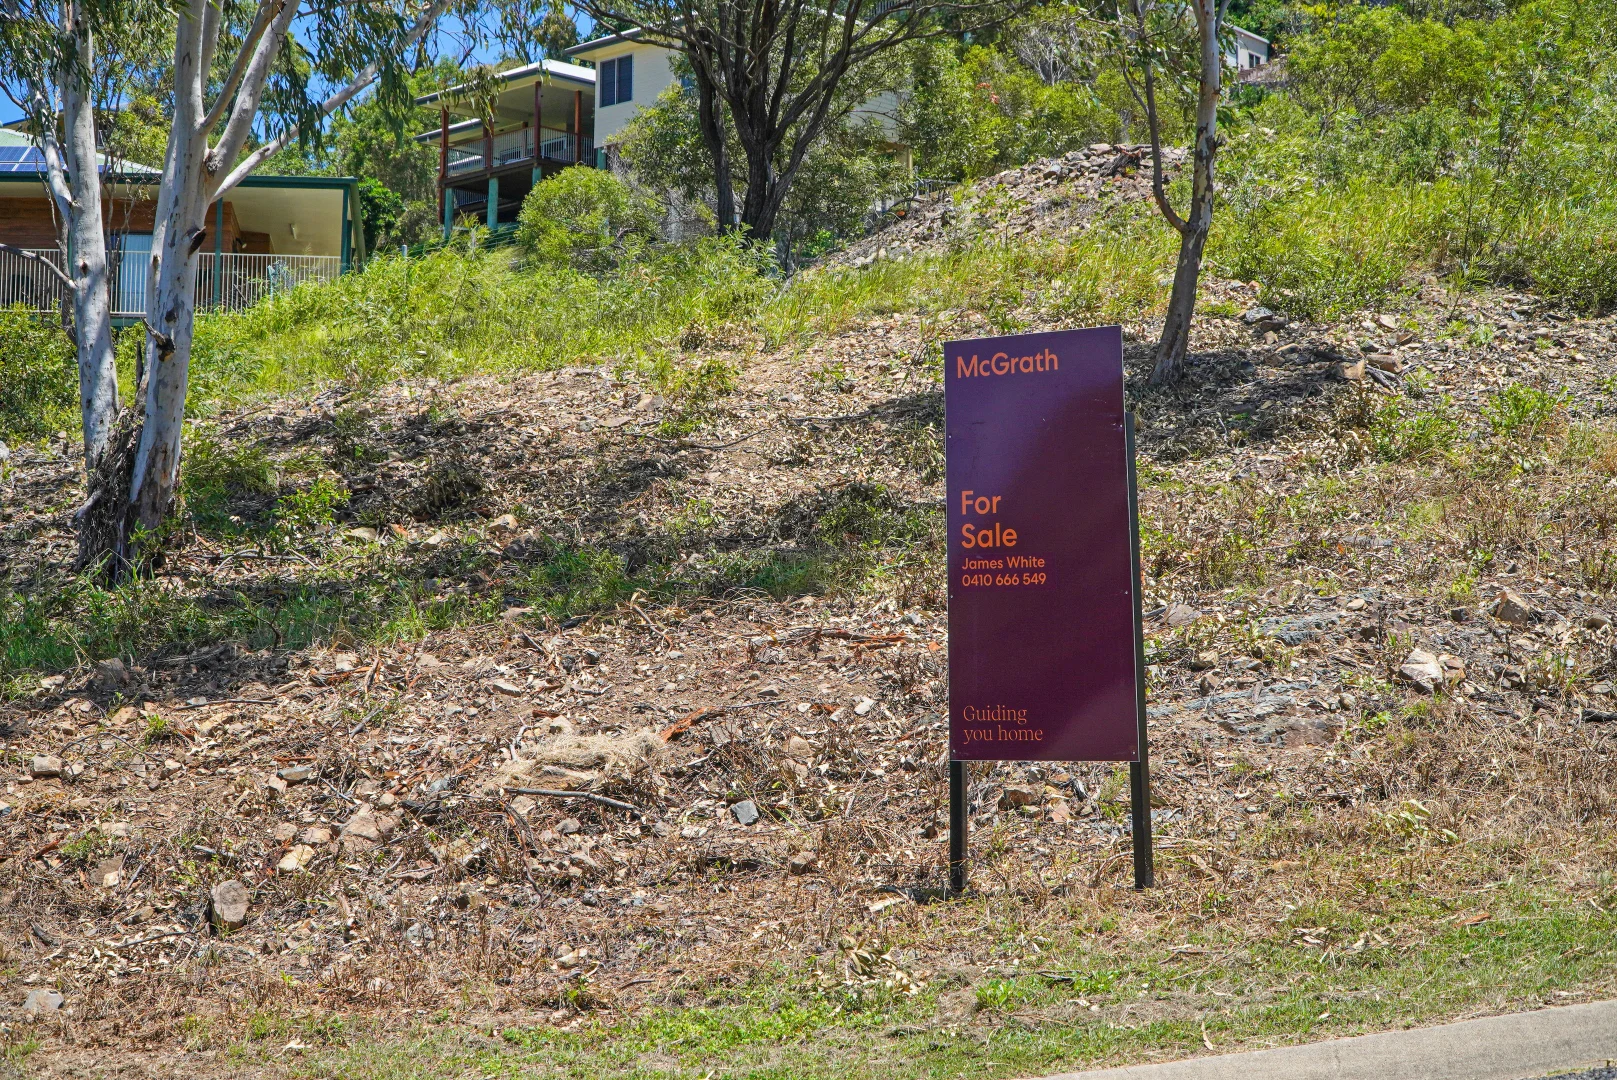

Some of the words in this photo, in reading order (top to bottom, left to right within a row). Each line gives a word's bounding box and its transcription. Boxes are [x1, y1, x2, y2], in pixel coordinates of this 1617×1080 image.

[957, 349, 1059, 379] McGrath
[961, 490, 1002, 515] For
[961, 522, 1018, 549] Sale
[962, 557, 1004, 570] James
[1006, 555, 1046, 569] White
[962, 573, 993, 587] 0410
[995, 573, 1020, 586] 666
[1022, 572, 1047, 586] 549
[963, 704, 1028, 725] Guiding
[963, 729, 993, 745] you
[998, 724, 1044, 741] home
